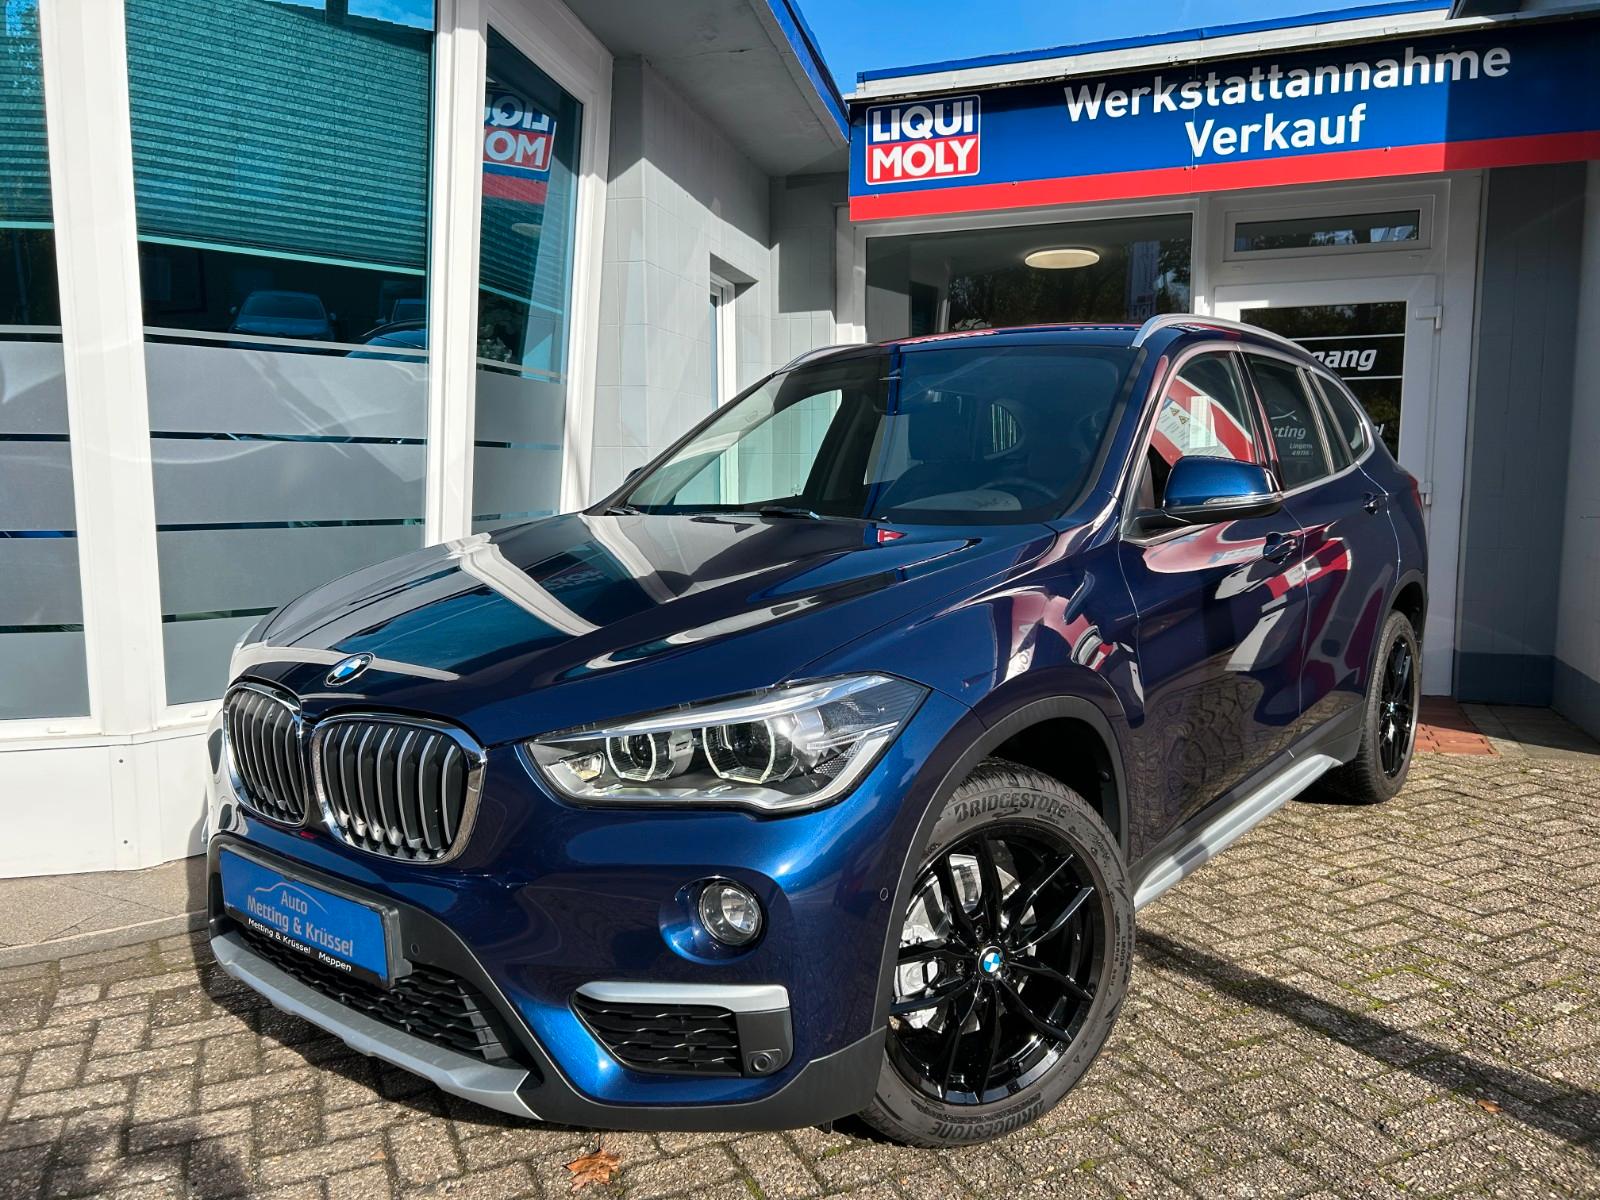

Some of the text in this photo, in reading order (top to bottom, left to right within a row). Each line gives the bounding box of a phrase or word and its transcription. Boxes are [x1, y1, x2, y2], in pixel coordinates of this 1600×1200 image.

[1064, 47, 1510, 122] Werkstattannahme
[872, 101, 973, 142] LIQUI
[1185, 103, 1367, 158] Verkauf
[872, 138, 977, 180] MOLY
[953, 792, 1070, 823] BRIDGESTONE
[247, 895, 353, 957] Metting & Krüssel
[281, 890, 308, 915] Auto
[248, 917, 352, 972] Metting & Krüssel Meppen
